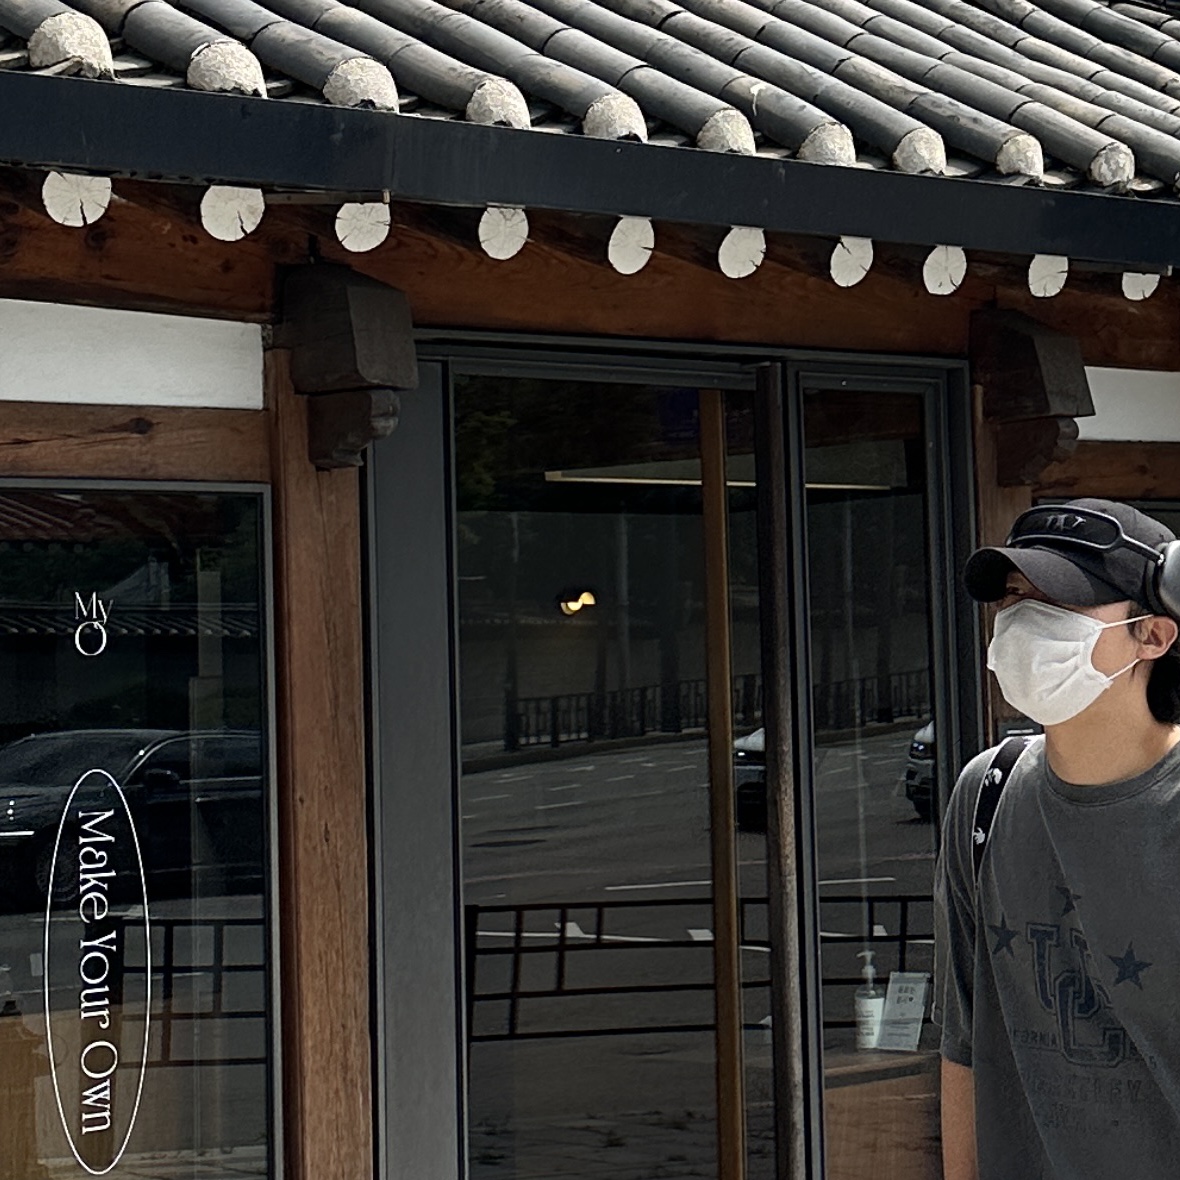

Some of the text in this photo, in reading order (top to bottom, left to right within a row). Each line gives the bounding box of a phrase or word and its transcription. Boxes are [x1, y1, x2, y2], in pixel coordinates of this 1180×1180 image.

[74, 591, 114, 628] My
[78, 809, 119, 1136] Make Your Own
